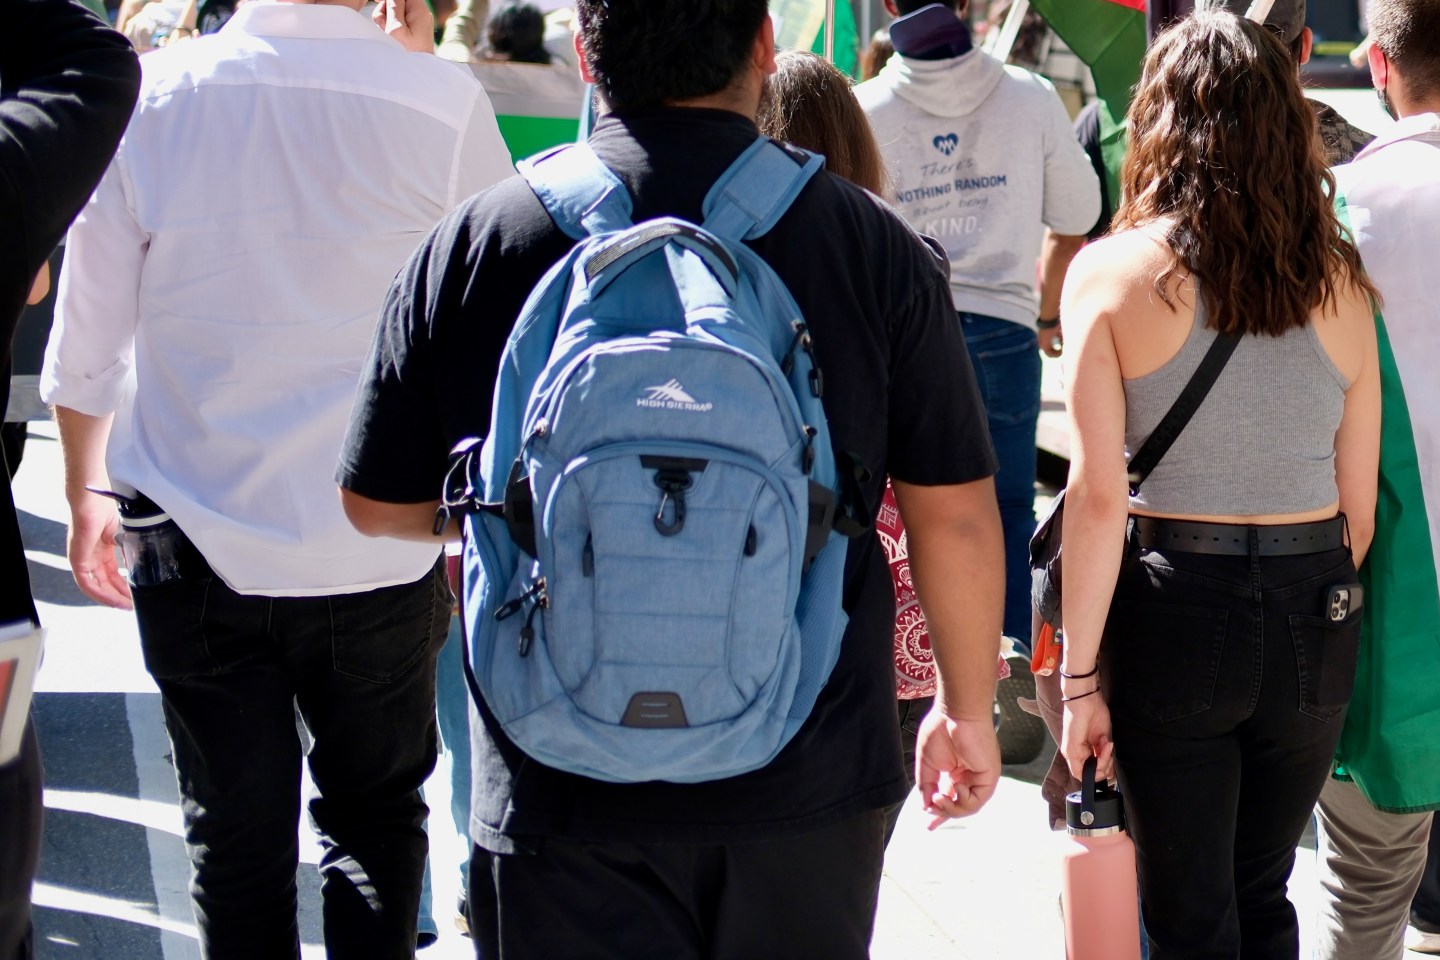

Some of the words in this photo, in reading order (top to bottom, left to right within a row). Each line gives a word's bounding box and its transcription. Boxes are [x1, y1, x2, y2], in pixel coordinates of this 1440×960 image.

[920, 156, 976, 178] There's
[896, 183, 952, 204] NOTHING
[954, 174, 1008, 192] RANDOM
[925, 215, 984, 237] KIND.
[636, 398, 665, 408] HIGH
